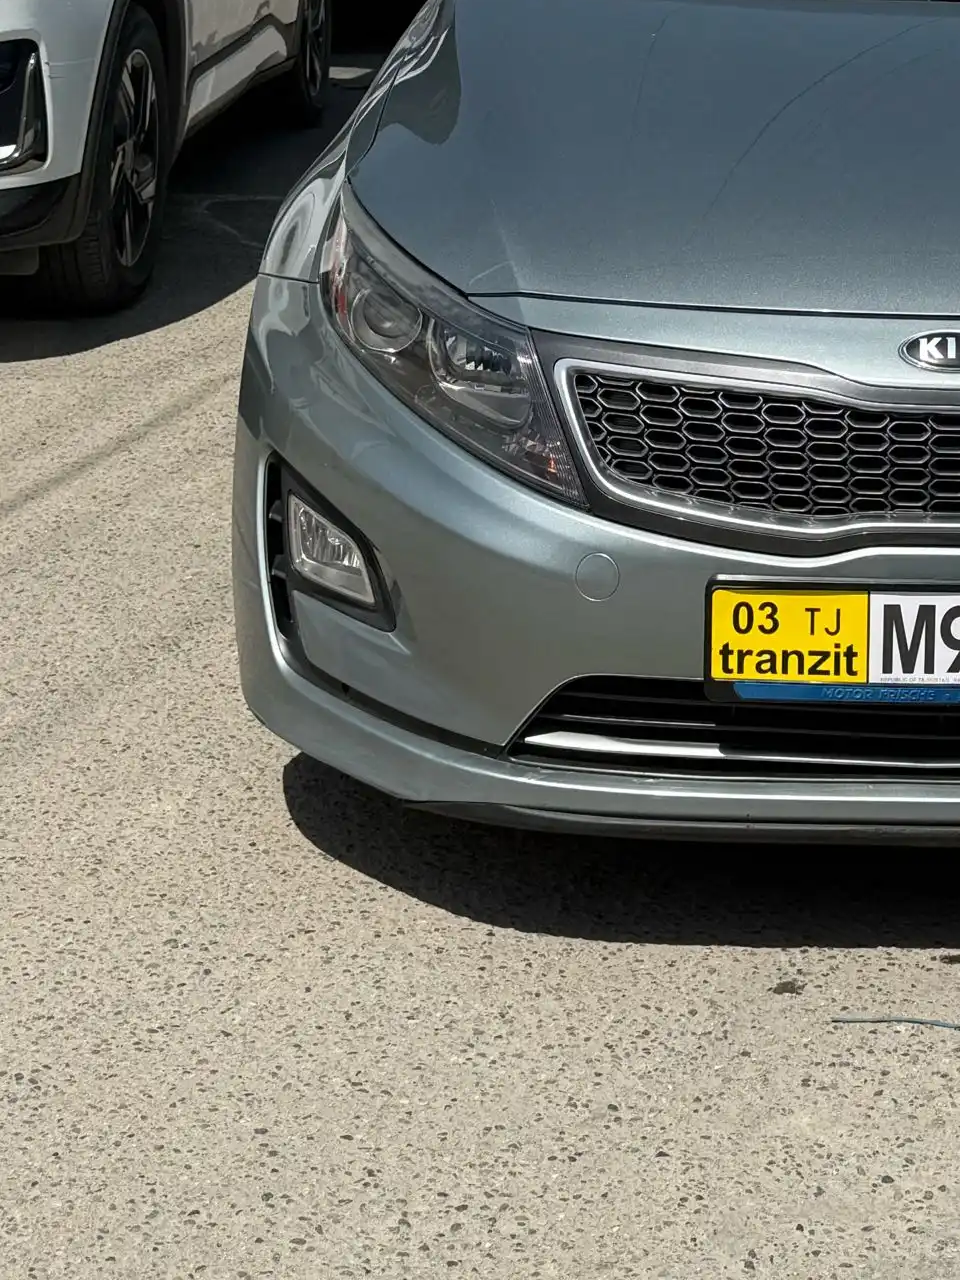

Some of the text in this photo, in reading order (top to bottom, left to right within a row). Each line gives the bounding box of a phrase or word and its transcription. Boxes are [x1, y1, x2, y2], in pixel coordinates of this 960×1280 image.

[732, 601, 841, 636] 03 TJ
[719, 641, 859, 676] tranzit
[820, 687, 874, 699] MOTOR
